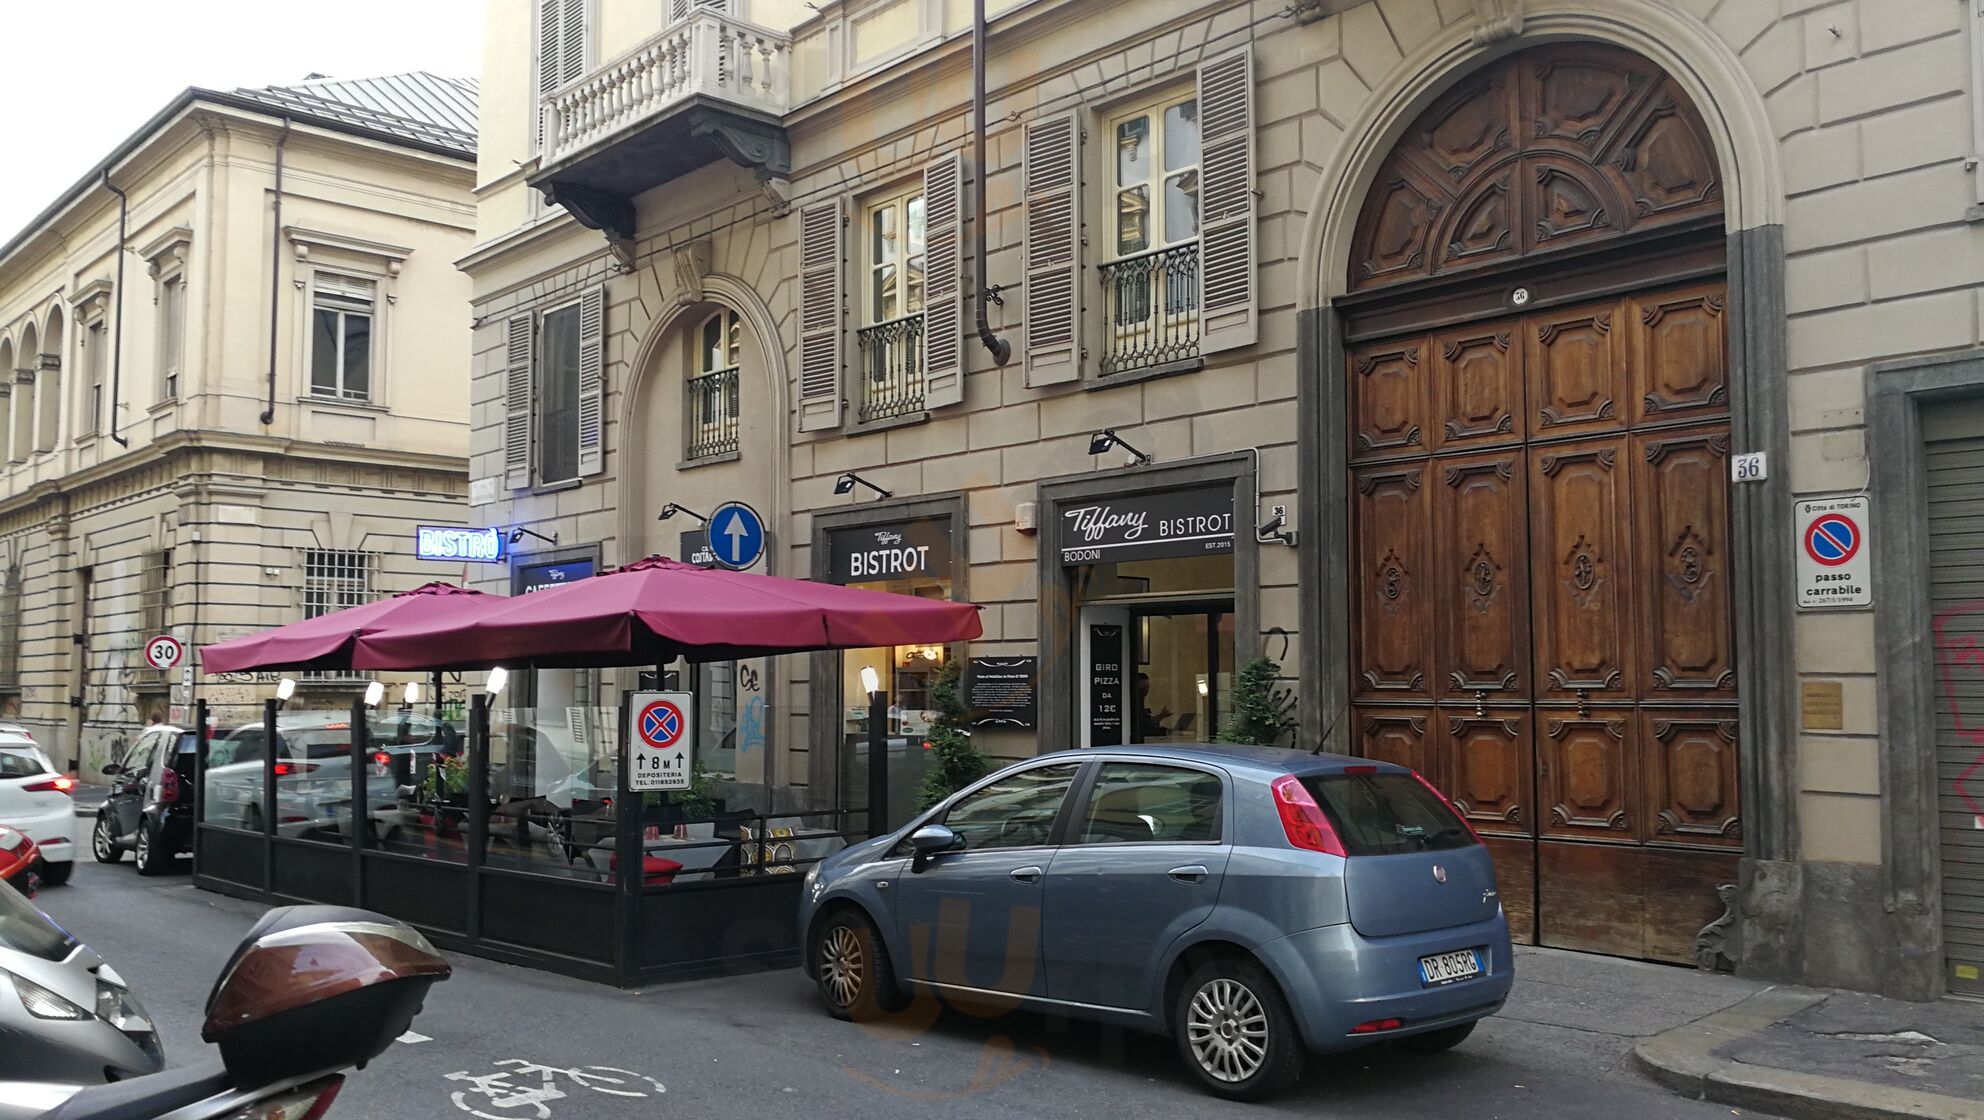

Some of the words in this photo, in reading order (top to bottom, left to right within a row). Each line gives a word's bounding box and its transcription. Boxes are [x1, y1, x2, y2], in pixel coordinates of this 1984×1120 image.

[1737, 456, 1760, 478] 36
[1274, 506, 1283, 515] 36
[1064, 506, 1148, 541] Tiffany
[1159, 513, 1231, 537] BISTROT
[874, 531, 902, 545] Tiffany
[850, 546, 929, 576] BISTROT
[1064, 549, 1101, 562] BODONI
[1815, 573, 1851, 583] passo
[1806, 585, 1862, 596] carrabile
[154, 645, 174, 660] 30
[1095, 663, 1118, 671] GIRO
[1094, 677, 1119, 685] PIZZA
[651, 756, 660, 770] 8
[663, 760, 671, 769] M
[1423, 958, 1442, 979] DR
